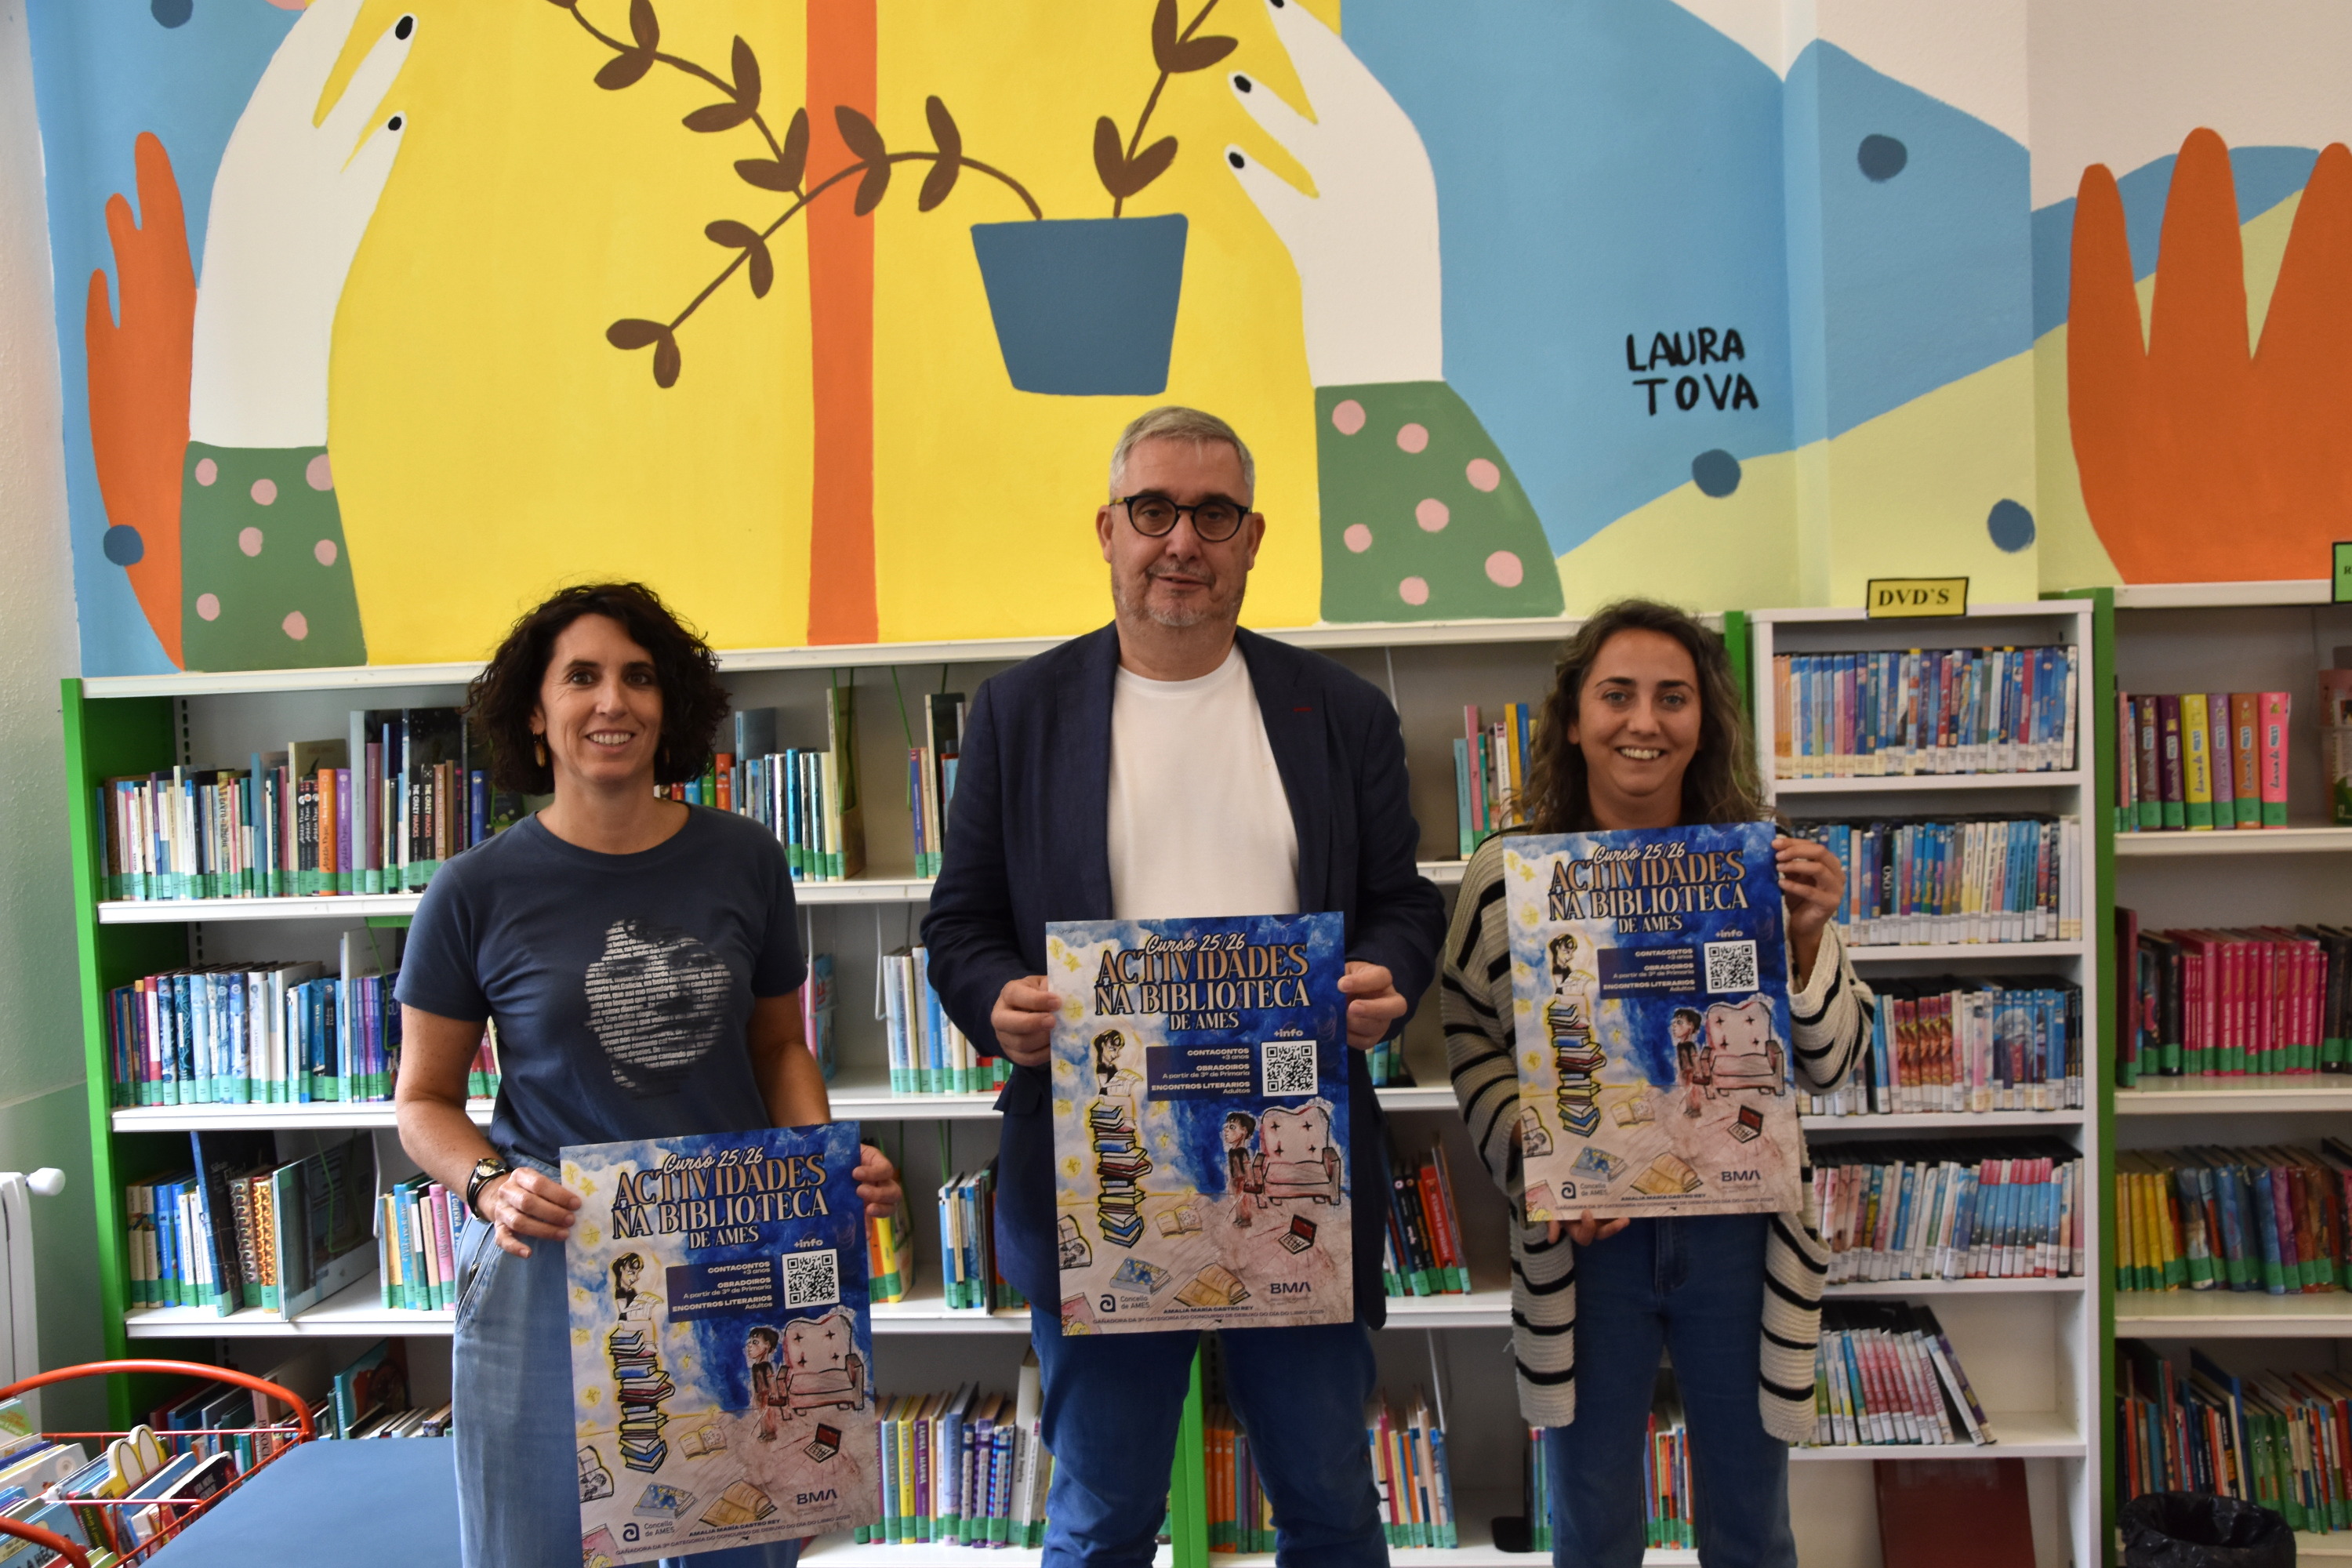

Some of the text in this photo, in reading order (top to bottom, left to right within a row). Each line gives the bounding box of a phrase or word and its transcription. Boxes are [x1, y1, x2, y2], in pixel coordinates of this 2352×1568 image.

[1627, 327, 1745, 372] LAURA
[1632, 372, 1759, 416] TOVA
[1593, 841, 1686, 864] Curso 25/26
[1549, 849, 1746, 892] ACTIVIDADES
[1548, 881, 1748, 920] NA BIBLIOTECA
[1617, 914, 1682, 933] DE AMES
[1715, 928, 1743, 938] +info
[1145, 932, 1246, 954] Curso 25/26
[1634, 948, 1693, 957] CONTACONTOS
[1097, 943, 1308, 984] ACTIVIDADES
[1643, 962, 1694, 971] OBRADOIROS
[1602, 982, 1650, 990] ENCONTROS
[1094, 977, 1310, 1014] NA BIBLIOTECA
[1170, 1011, 1240, 1030] DE AMES
[1273, 1028, 1304, 1037] +info
[1186, 1047, 1250, 1056] CONTACONTOS
[1196, 1063, 1250, 1072] OBRADOIROS
[1151, 1083, 1202, 1091] ENCONTROS
[662, 1146, 764, 1174] Curso 25/26
[612, 1152, 828, 1207] ACTIVIDADES
[452, 1198, 462, 1227] GUERRA
[612, 1187, 829, 1239] NA BIBLIOTECA
[689, 1225, 760, 1249] DE AMES
[793, 1237, 824, 1249] +info
[707, 1261, 771, 1274] CONTACONTOS
[689, 1290, 710, 1299] partir
[741, 1283, 771, 1292] Primaria
[717, 1276, 771, 1289] OBRADOIROS
[672, 1294, 772, 1312] ENCONTROS LITERARIOS
[744, 1301, 773, 1310] Adultos
[644, 1519, 673, 1530] Concello
[655, 1526, 675, 1535] AMES
[688, 1528, 716, 1537] AMALIA
[739, 1520, 767, 1530] CASTRO
